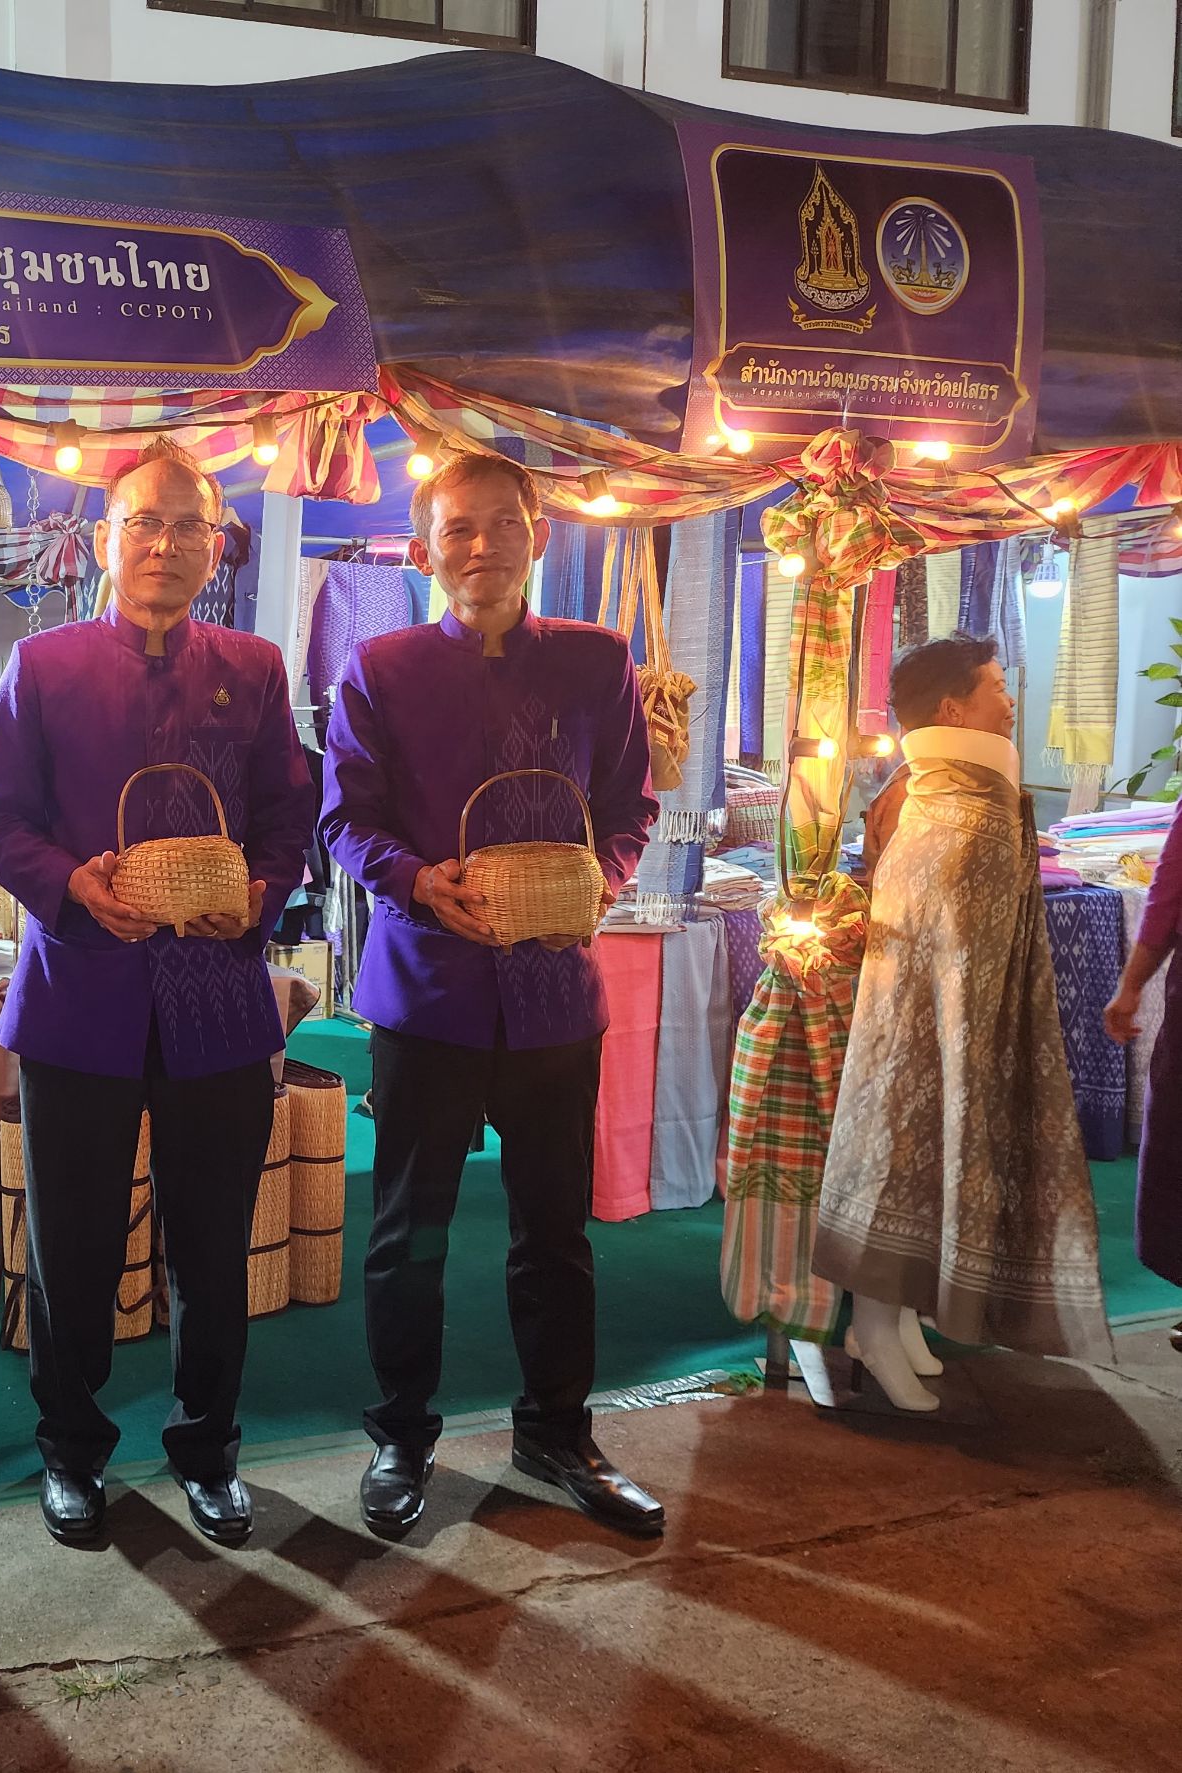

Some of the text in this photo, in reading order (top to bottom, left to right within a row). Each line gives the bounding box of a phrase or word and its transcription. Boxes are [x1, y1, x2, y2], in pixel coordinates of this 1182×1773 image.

[120, 302, 214, 322] CCPOT)
[740, 358, 999, 401] สำนักงานวัฒนธรรมจังหวัดยโสธร
[752, 387, 810, 399] Yasothon
[890, 395, 940, 409] Cultural
[947, 401, 984, 411] Office
